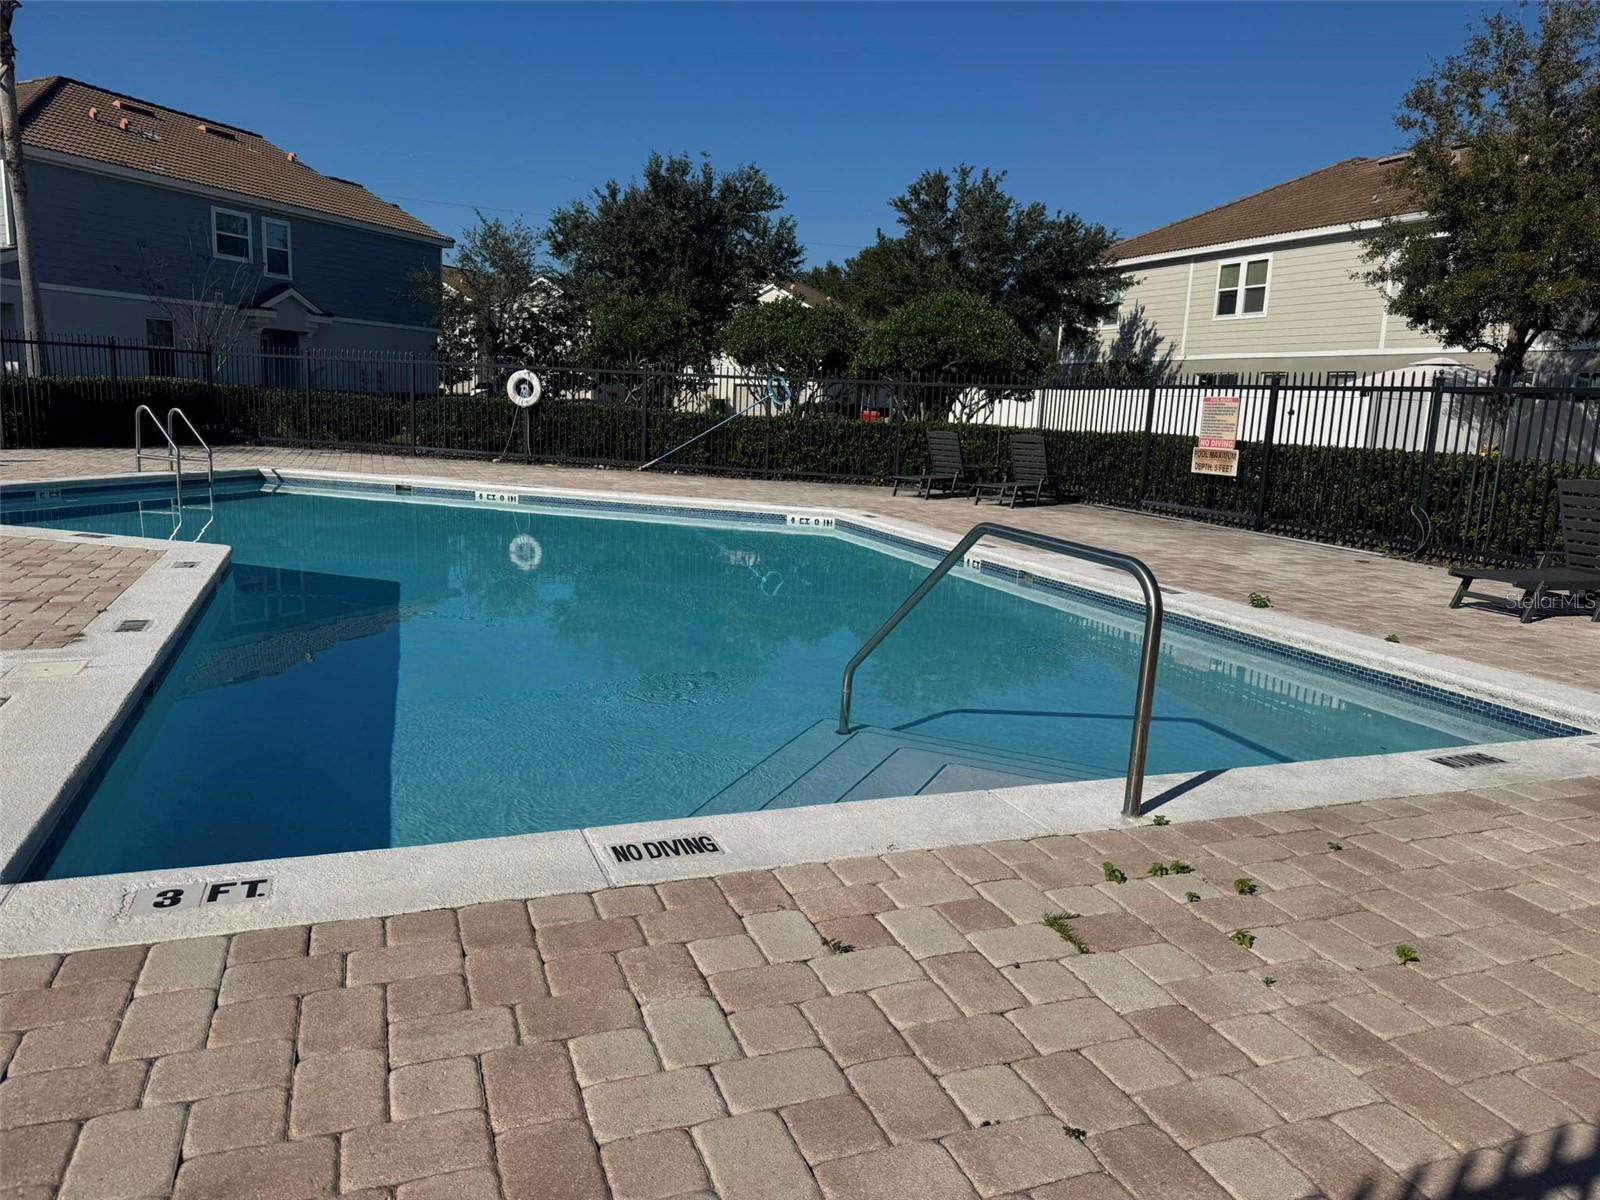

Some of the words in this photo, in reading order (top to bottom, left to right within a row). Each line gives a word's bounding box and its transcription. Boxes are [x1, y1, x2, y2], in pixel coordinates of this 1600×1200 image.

[1200, 439, 1210, 447] NO
[1211, 440, 1234, 448] DIVING
[1209, 451, 1237, 460] MAXIMUM
[1219, 464, 1233, 473] FEET
[611, 844, 643, 862] NO
[642, 836, 720, 859] DIVING
[153, 889, 184, 908] 3
[206, 879, 268, 903] FT.
